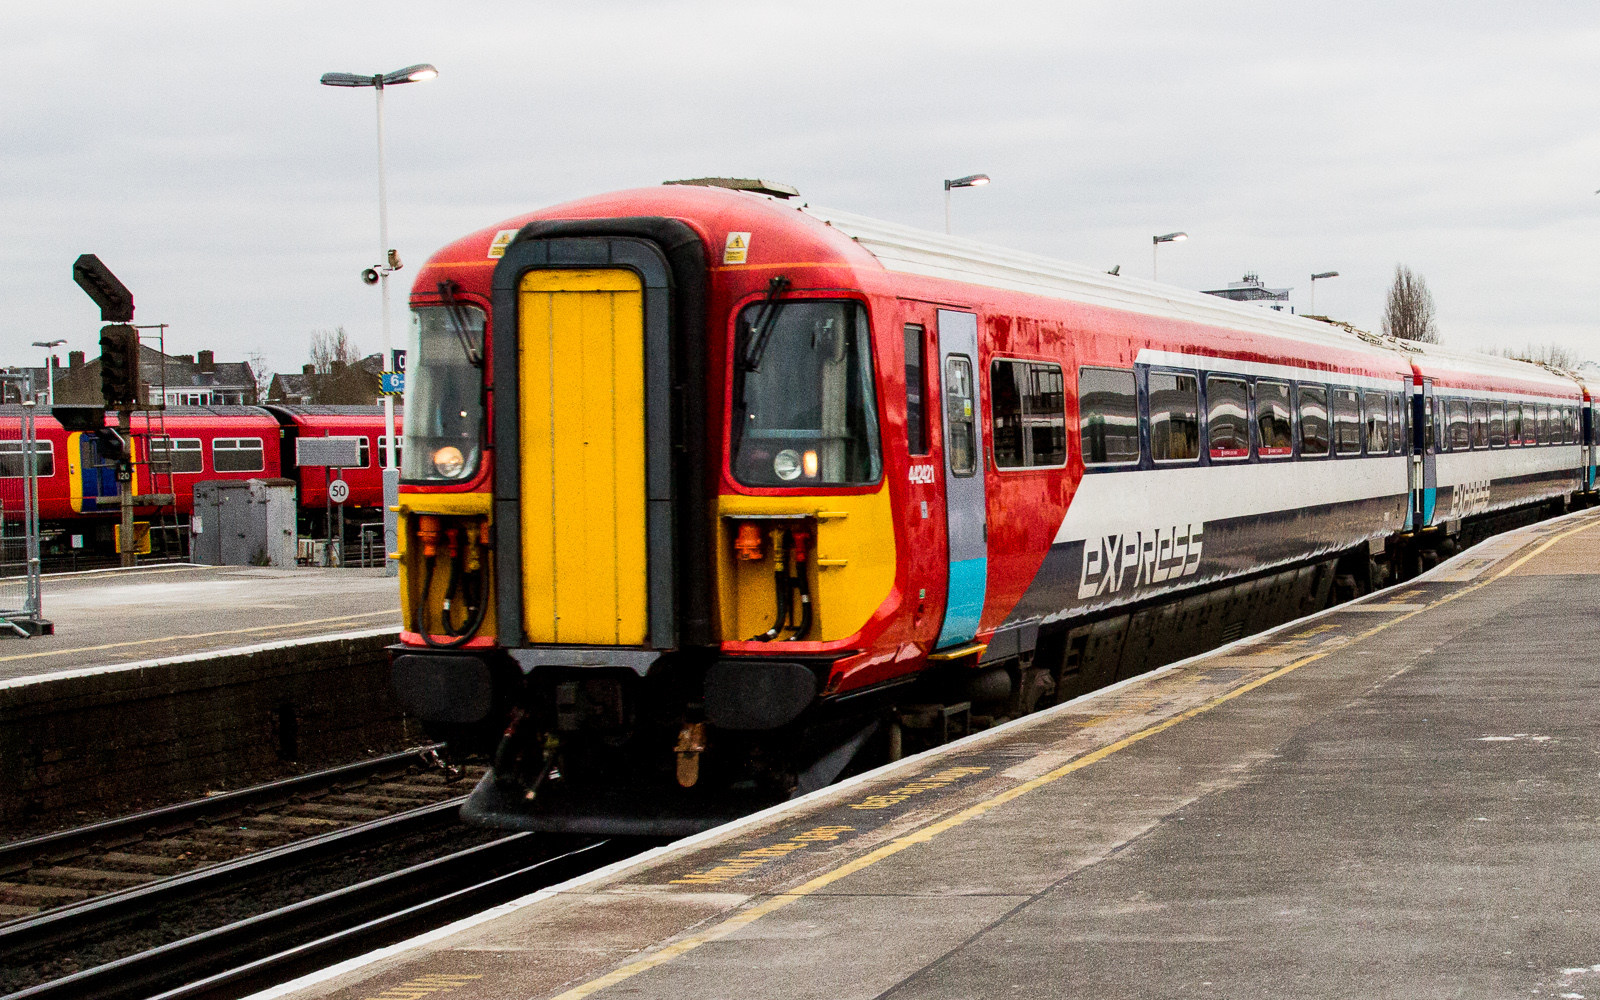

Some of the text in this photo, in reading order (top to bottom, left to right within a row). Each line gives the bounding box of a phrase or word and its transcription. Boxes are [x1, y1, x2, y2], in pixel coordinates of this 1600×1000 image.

[332, 485, 346, 497] 50
[668, 825, 857, 884] Mind the gap
